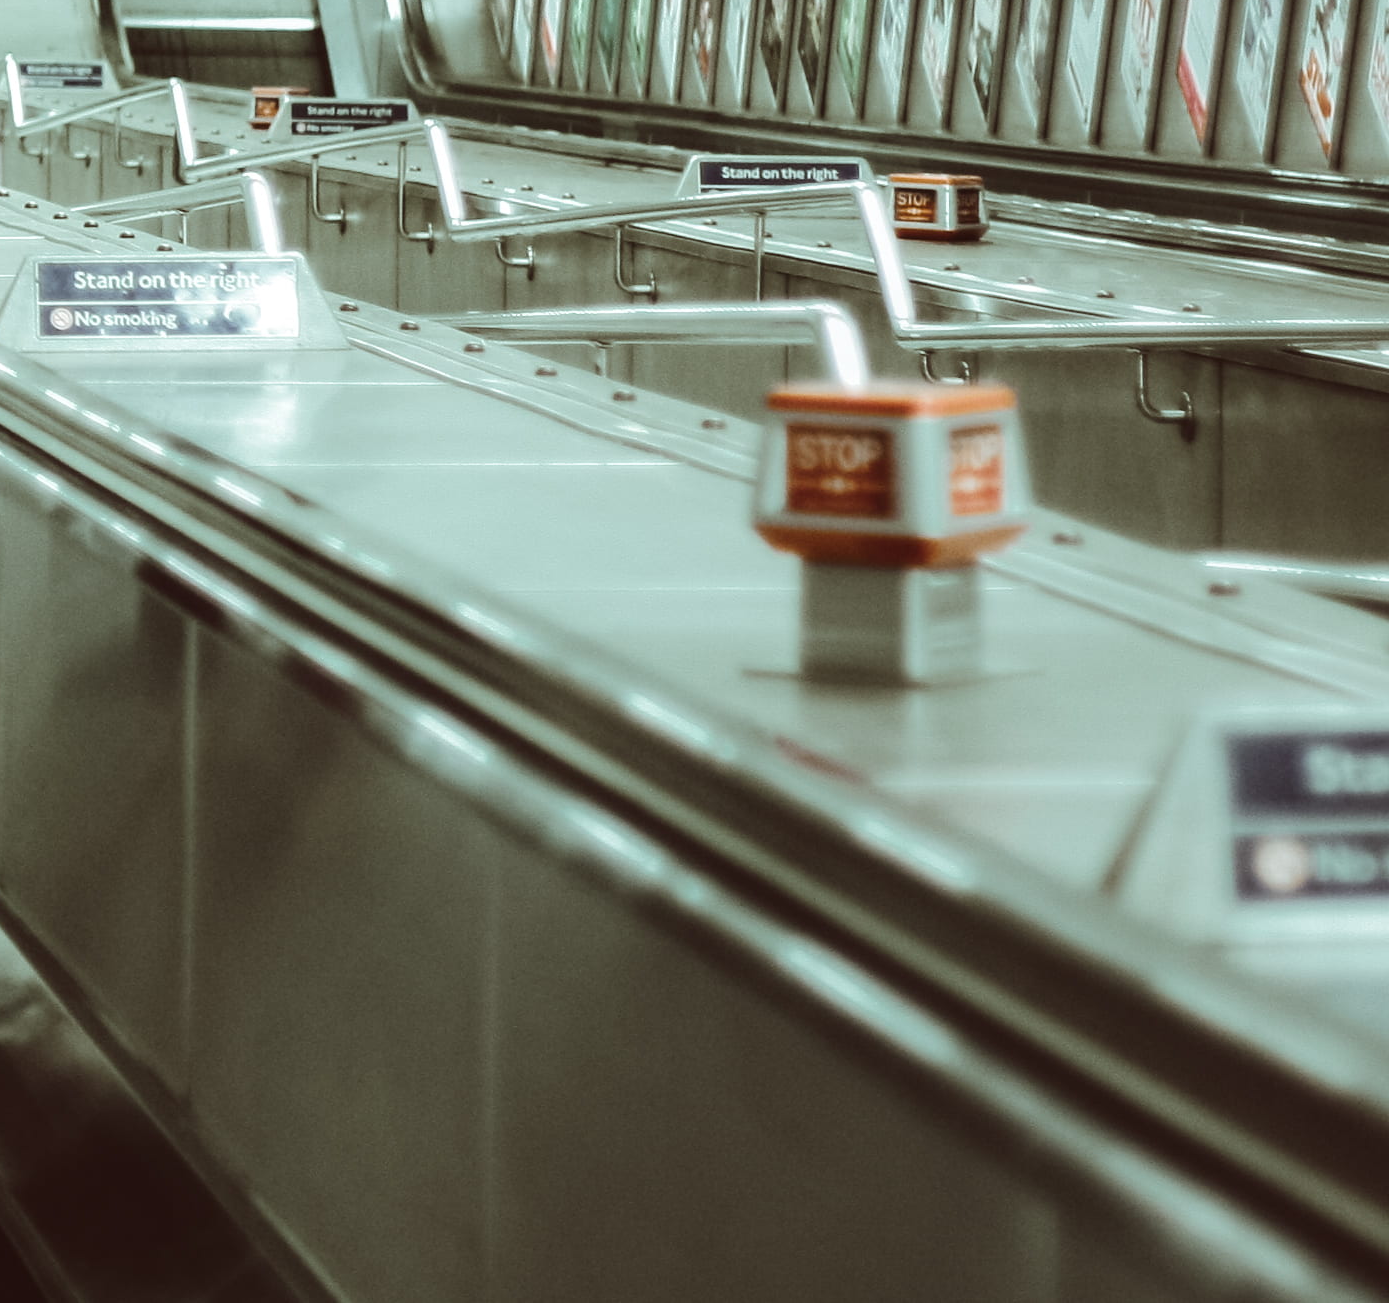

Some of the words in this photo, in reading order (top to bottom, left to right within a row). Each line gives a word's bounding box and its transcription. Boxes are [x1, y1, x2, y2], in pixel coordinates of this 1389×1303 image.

[307, 106, 335, 116] Stand
[337, 107, 349, 116] on
[351, 107, 367, 116] the
[370, 107, 392, 118] right
[721, 166, 761, 180] Stand
[762, 168, 780, 180] on
[781, 167, 805, 180] the
[807, 167, 839, 183] right
[74, 270, 135, 290] Stand
[138, 273, 166, 290] on
[170, 270, 207, 290] the
[210, 269, 261, 293] right
[74, 310, 102, 327] No
[104, 308, 178, 329] smoking
[796, 434, 882, 473] STOP
